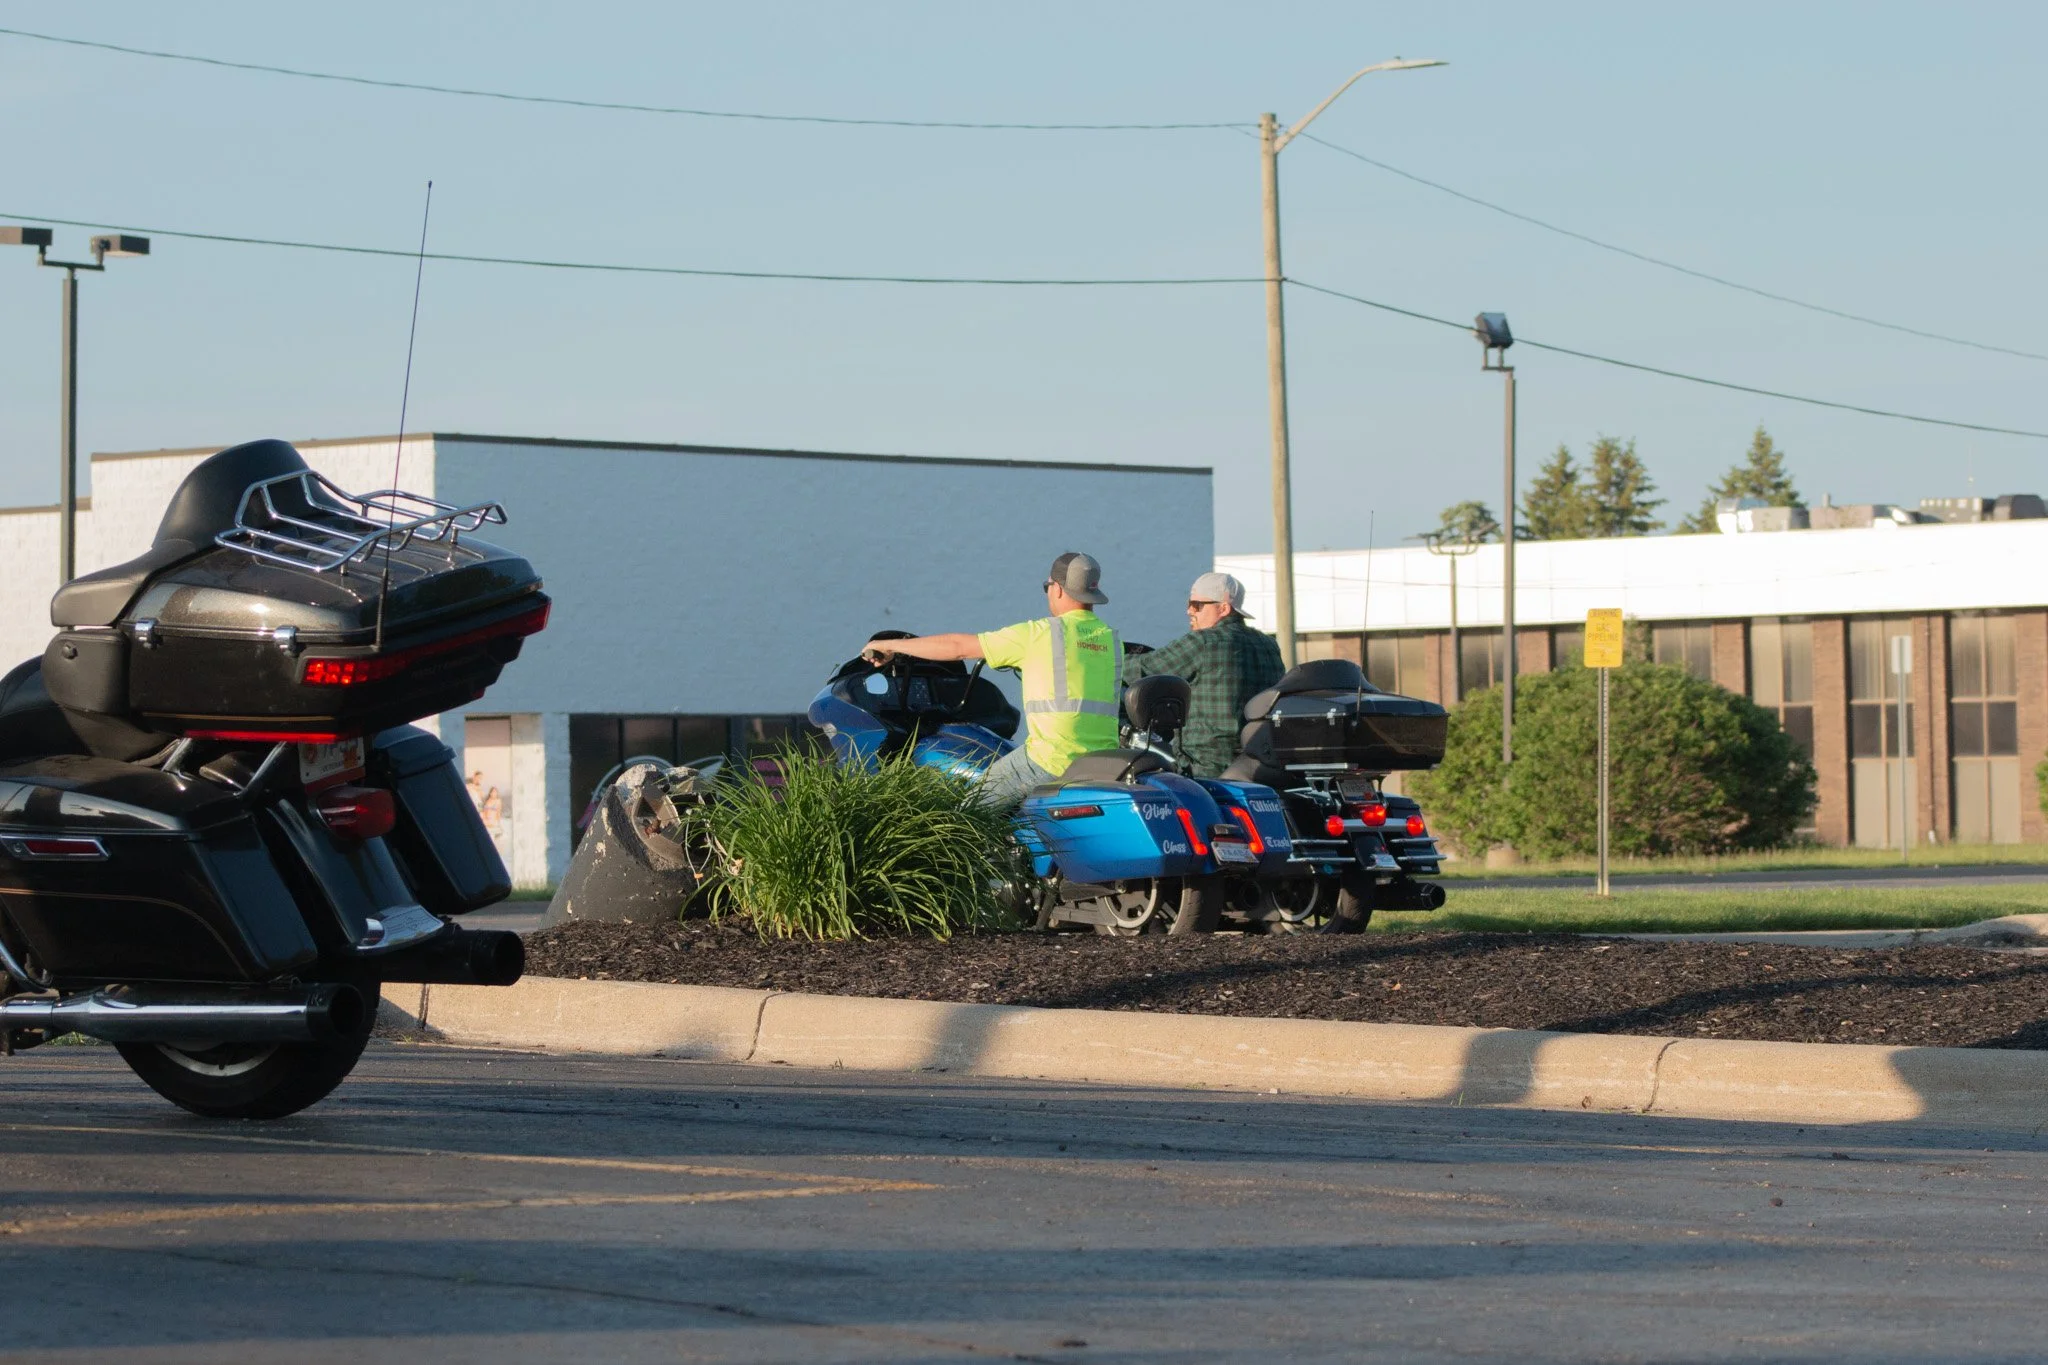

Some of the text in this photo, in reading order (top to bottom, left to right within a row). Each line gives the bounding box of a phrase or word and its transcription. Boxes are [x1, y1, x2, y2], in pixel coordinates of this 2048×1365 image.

[1587, 633, 1619, 642] PIPELINE
[1142, 803, 1172, 820] High
[1248, 799, 1280, 813] White
[1162, 839, 1187, 854] Class
[1264, 836, 1291, 849] Trash
